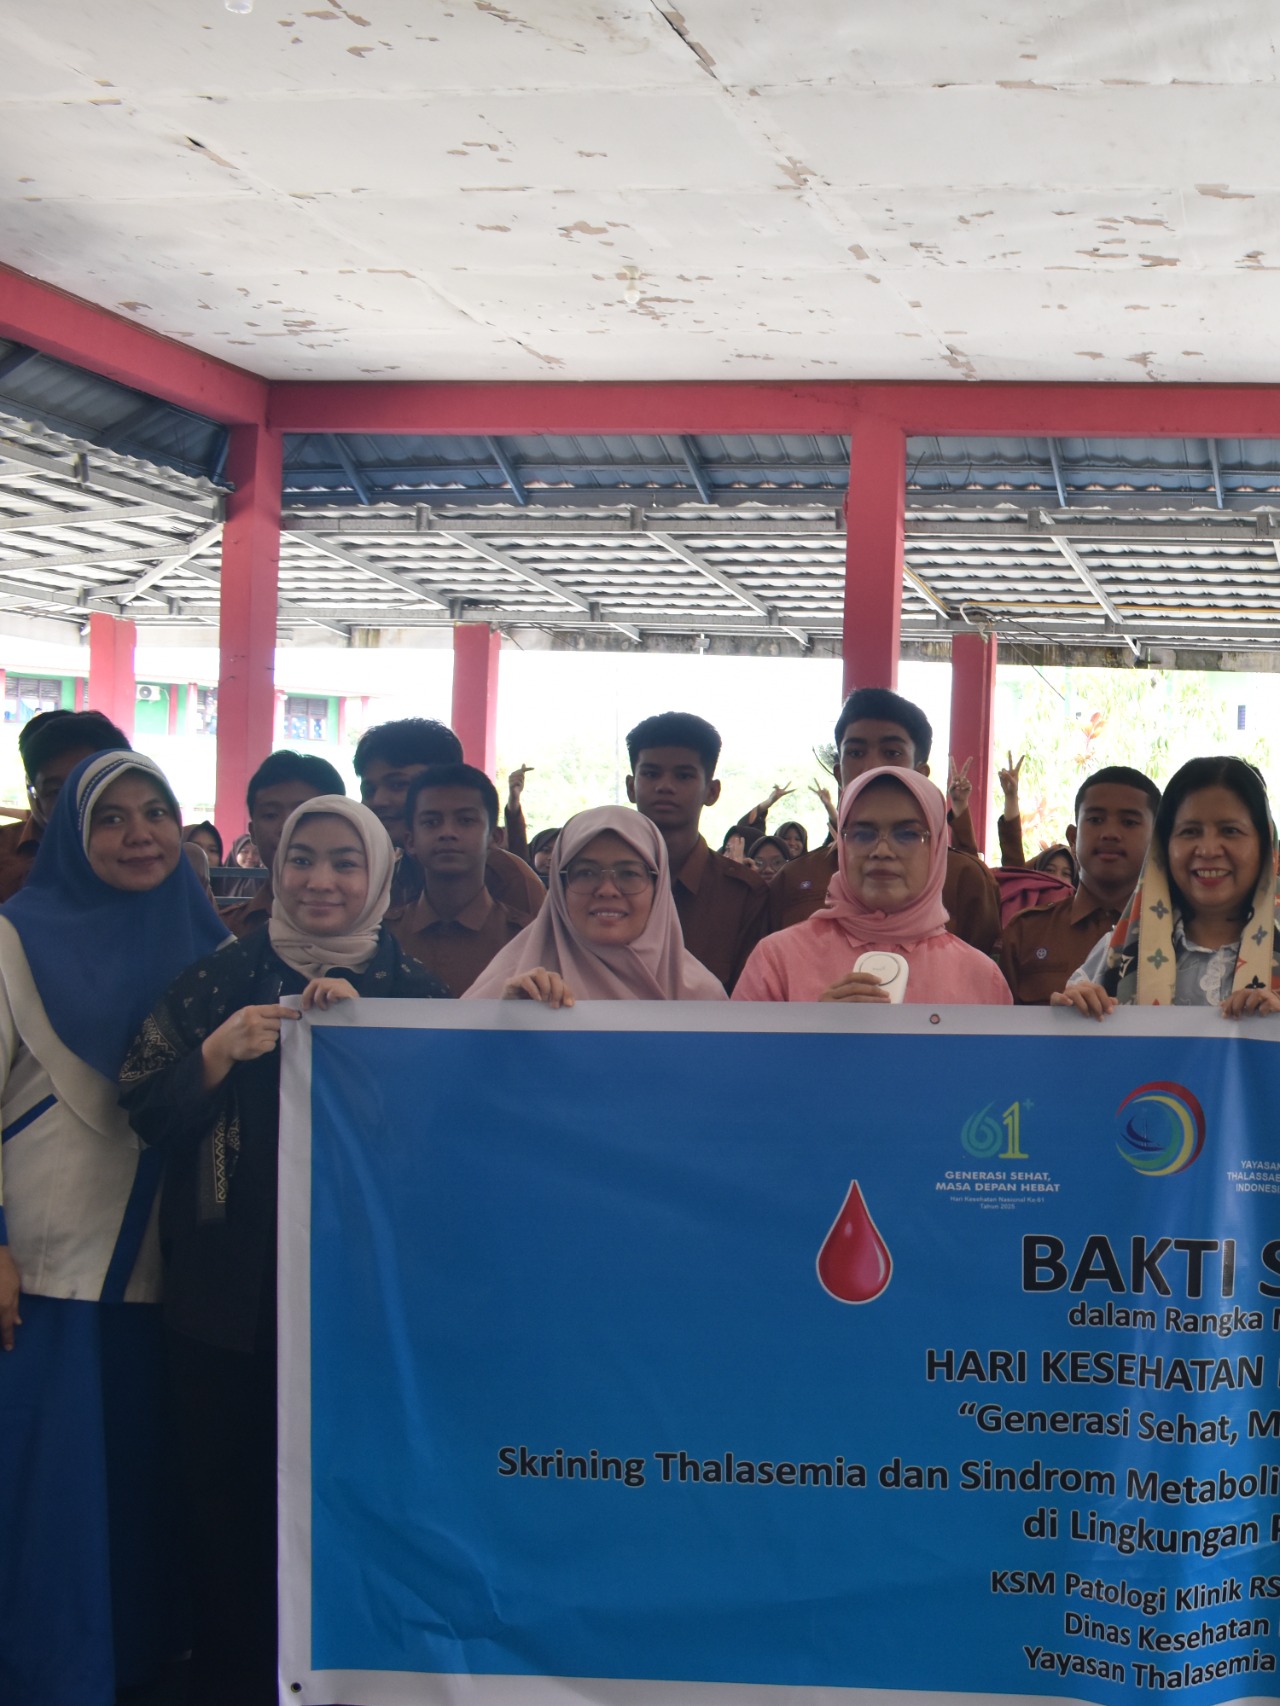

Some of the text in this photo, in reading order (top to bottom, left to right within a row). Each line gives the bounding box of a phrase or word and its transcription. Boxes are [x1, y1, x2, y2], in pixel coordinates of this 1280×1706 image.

[935, 1182, 1061, 1192] MASA DEPAN HEBAT
[944, 1171, 1051, 1182] GENERASI SEHAT,
[1023, 1235, 1235, 1298] BAKTI
[1068, 1301, 1156, 1329] dalam
[1165, 1307, 1263, 1337] Rangka
[927, 1349, 1026, 1382] HARI
[1043, 1351, 1263, 1392] KESEHATAN
[1138, 1412, 1237, 1445] Sehat,
[498, 1446, 645, 1487] Skrining
[655, 1451, 866, 1487] Thalasemia
[879, 1458, 948, 1489] dan
[961, 1460, 1115, 1495] Sindrom
[1024, 1507, 1057, 1538] di
[1071, 1511, 1258, 1556] Lingkungan
[992, 1571, 1055, 1594] KSM
[1065, 1573, 1166, 1615] Patologi
[1176, 1578, 1242, 1611] Klinik
[1065, 1612, 1131, 1646] Dinas
[1138, 1614, 1269, 1652] Kesehatan
[1024, 1646, 1125, 1682] Yayasan
[1132, 1650, 1276, 1689] Thalasemia
